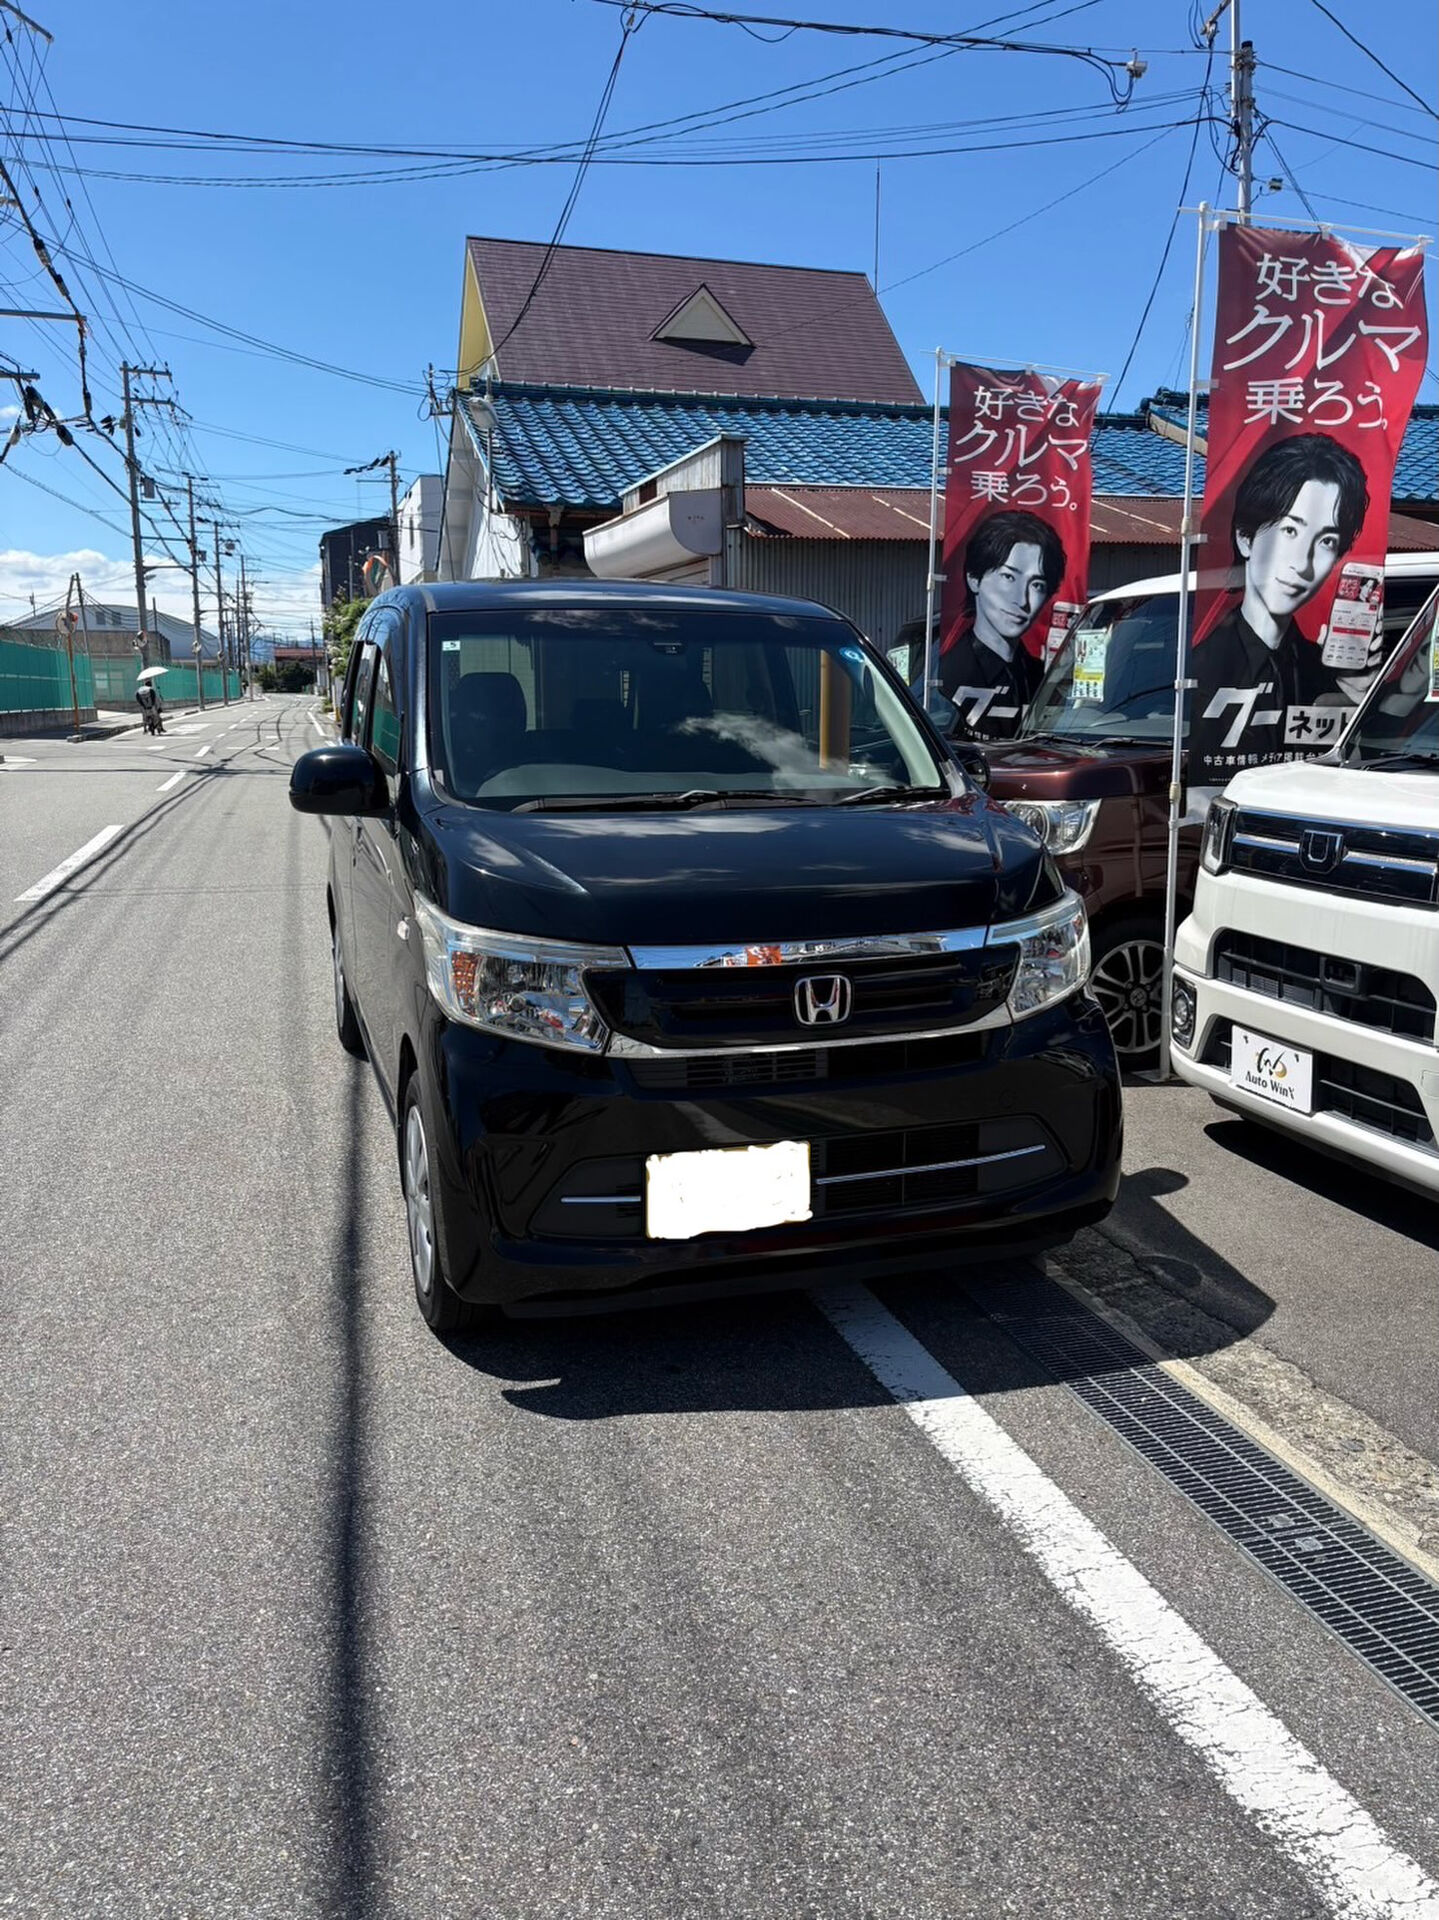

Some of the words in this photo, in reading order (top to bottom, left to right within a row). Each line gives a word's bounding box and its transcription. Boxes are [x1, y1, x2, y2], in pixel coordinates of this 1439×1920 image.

[1256, 253, 1403, 309] 好きな
[1223, 304, 1422, 373] クルマ
[973, 385, 1080, 428] 好きな
[954, 420, 1088, 471] クルマ
[970, 470, 1077, 511] 乗ろう。
[1245, 1070, 1268, 1088] Auto
